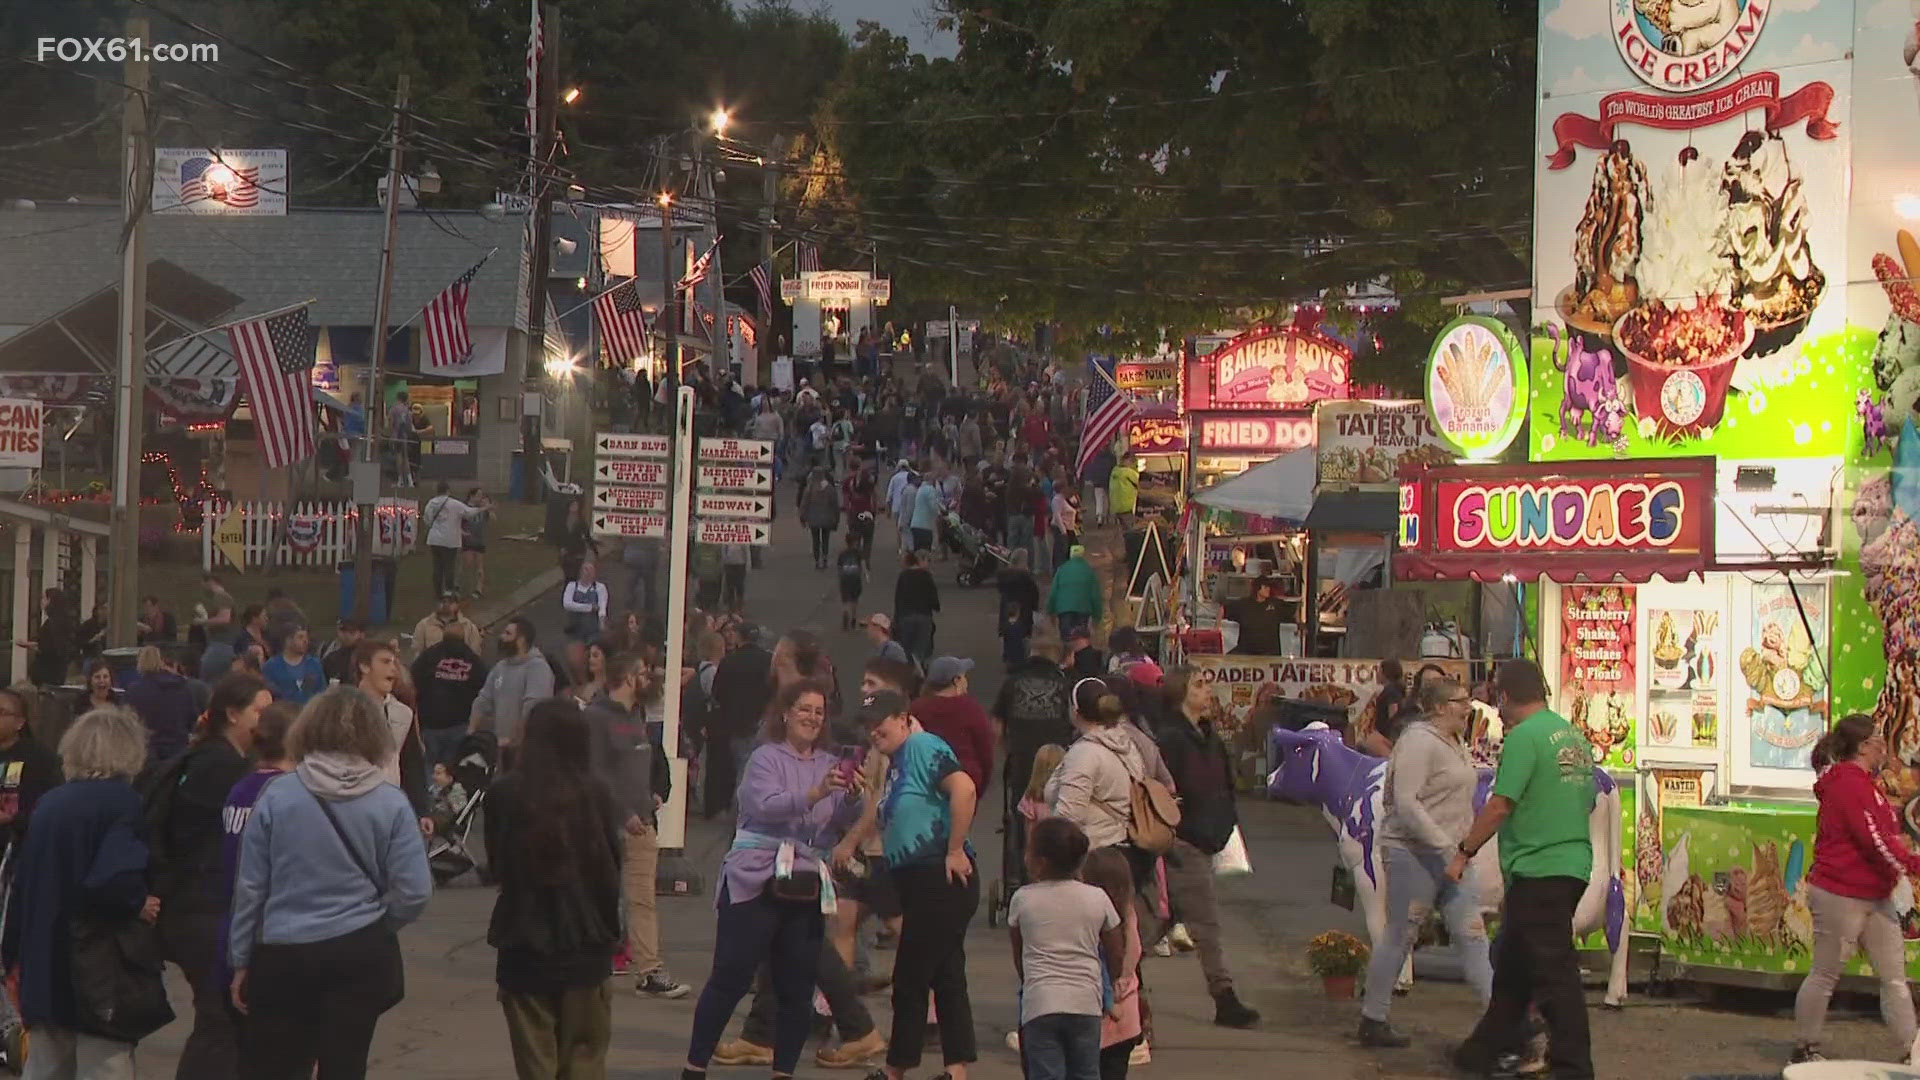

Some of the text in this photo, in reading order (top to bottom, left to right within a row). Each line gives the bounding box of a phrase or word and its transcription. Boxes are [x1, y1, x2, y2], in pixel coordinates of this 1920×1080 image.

[1618, 3, 1763, 85] ICE CREAM
[1607, 80, 1773, 120] The WORLD'S GREATEST ICE CREAM
[811, 280, 860, 290] FRIED DOUGH
[1220, 335, 1346, 386] BAKERY BOYS
[1373, 403, 1420, 414] LOADED
[1335, 413, 1406, 436] TATER
[1448, 420, 1497, 432] Bananas
[1202, 420, 1269, 446] FRIED
[1275, 420, 1313, 448] DO
[609, 440, 667, 451] BARN BLVD
[722, 440, 738, 450] THE
[1373, 435, 1420, 447] HEAVEN
[700, 448, 759, 460] MARKETPLACE
[611, 462, 662, 474] CENTER
[702, 467, 755, 479] MEMORY
[616, 473, 657, 483] STAGE
[712, 477, 745, 487] LANE
[608, 488, 664, 500] MOTORIZED
[616, 498, 655, 508] EVENTS
[702, 500, 752, 511] MIDWAY
[1453, 482, 1685, 548] SUNDAES
[620, 525, 648, 535] EXIT
[705, 523, 750, 533] ROLLER
[221, 532, 242, 544] ENTER
[701, 532, 752, 543] COASTER
[1567, 607, 1630, 624] Strawberry
[1576, 627, 1620, 642] Shakes,
[1574, 646, 1622, 660] Sundaes
[1202, 667, 1265, 684] OADED
[1269, 663, 1336, 683] TATER
[1574, 665, 1622, 680] & Floats
[1664, 779, 1695, 791] WANTED
